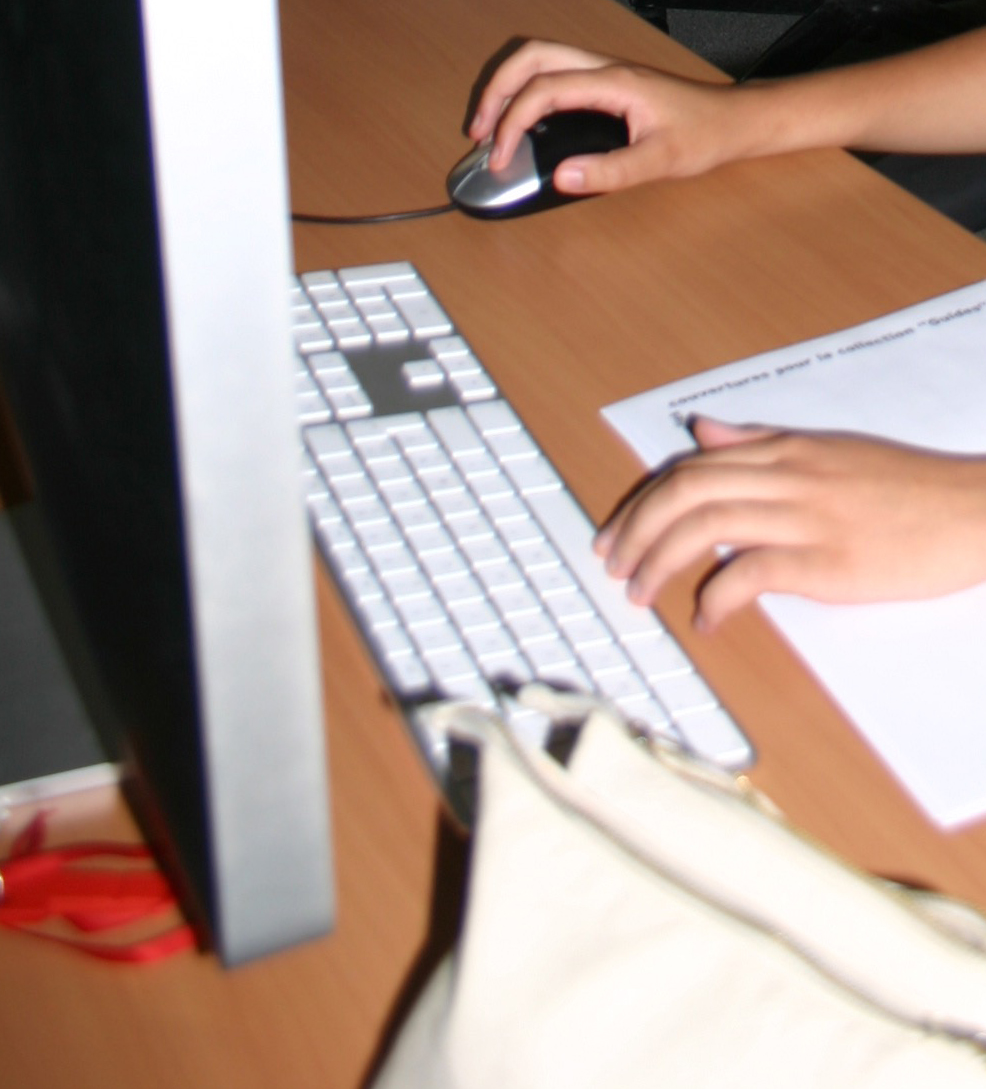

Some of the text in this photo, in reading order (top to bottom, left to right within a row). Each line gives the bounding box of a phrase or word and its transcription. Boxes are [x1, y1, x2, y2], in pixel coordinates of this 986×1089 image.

[668, 371, 770, 407] couvertures
[775, 358, 811, 376] pour
[837, 326, 915, 355] collection
